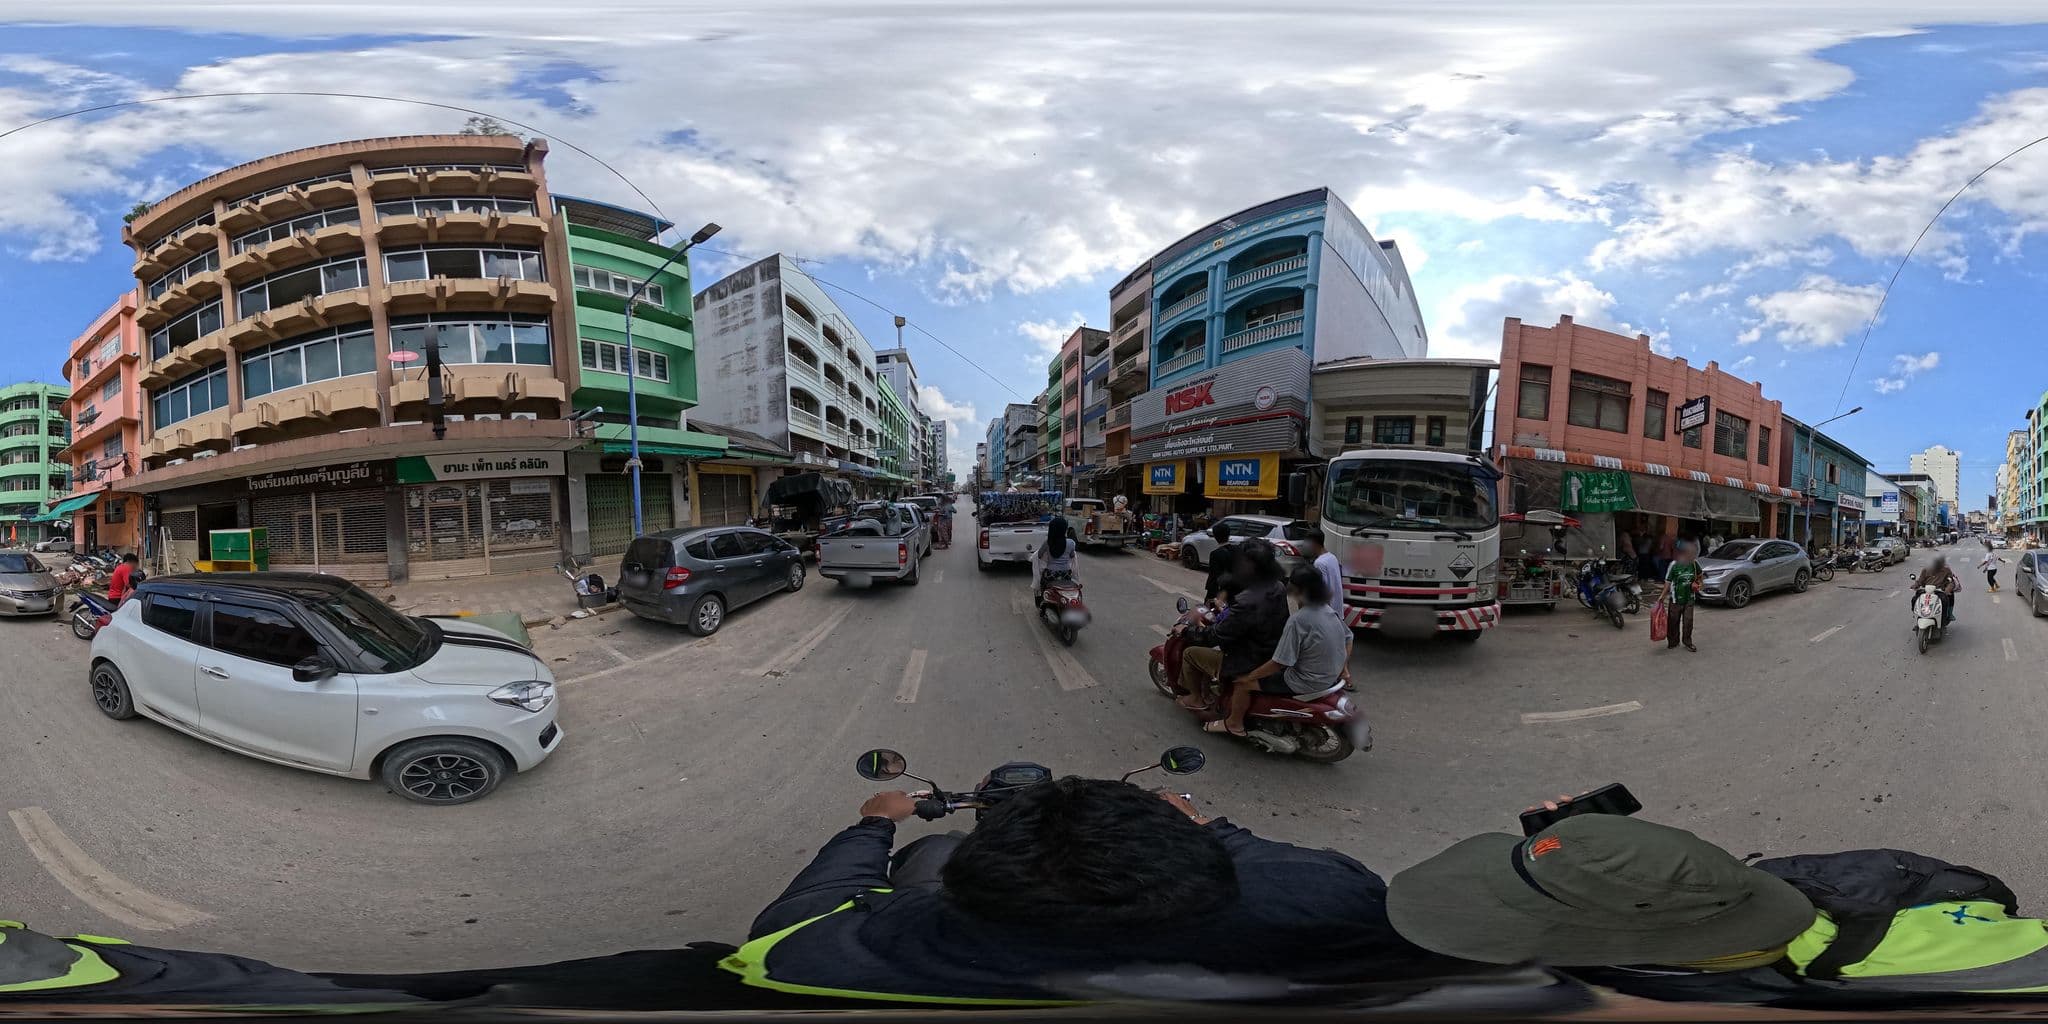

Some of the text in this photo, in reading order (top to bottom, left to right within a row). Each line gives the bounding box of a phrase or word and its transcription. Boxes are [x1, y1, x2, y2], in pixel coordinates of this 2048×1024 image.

[1165, 381, 1216, 416] NSK
[443, 463, 470, 474] ยามะ
[472, 458, 493, 472] เพ็ท
[496, 457, 517, 471] แคร์
[1154, 467, 1171, 478] NTN
[1225, 462, 1253, 476] NTN
[1383, 567, 1437, 578] ISUZU
